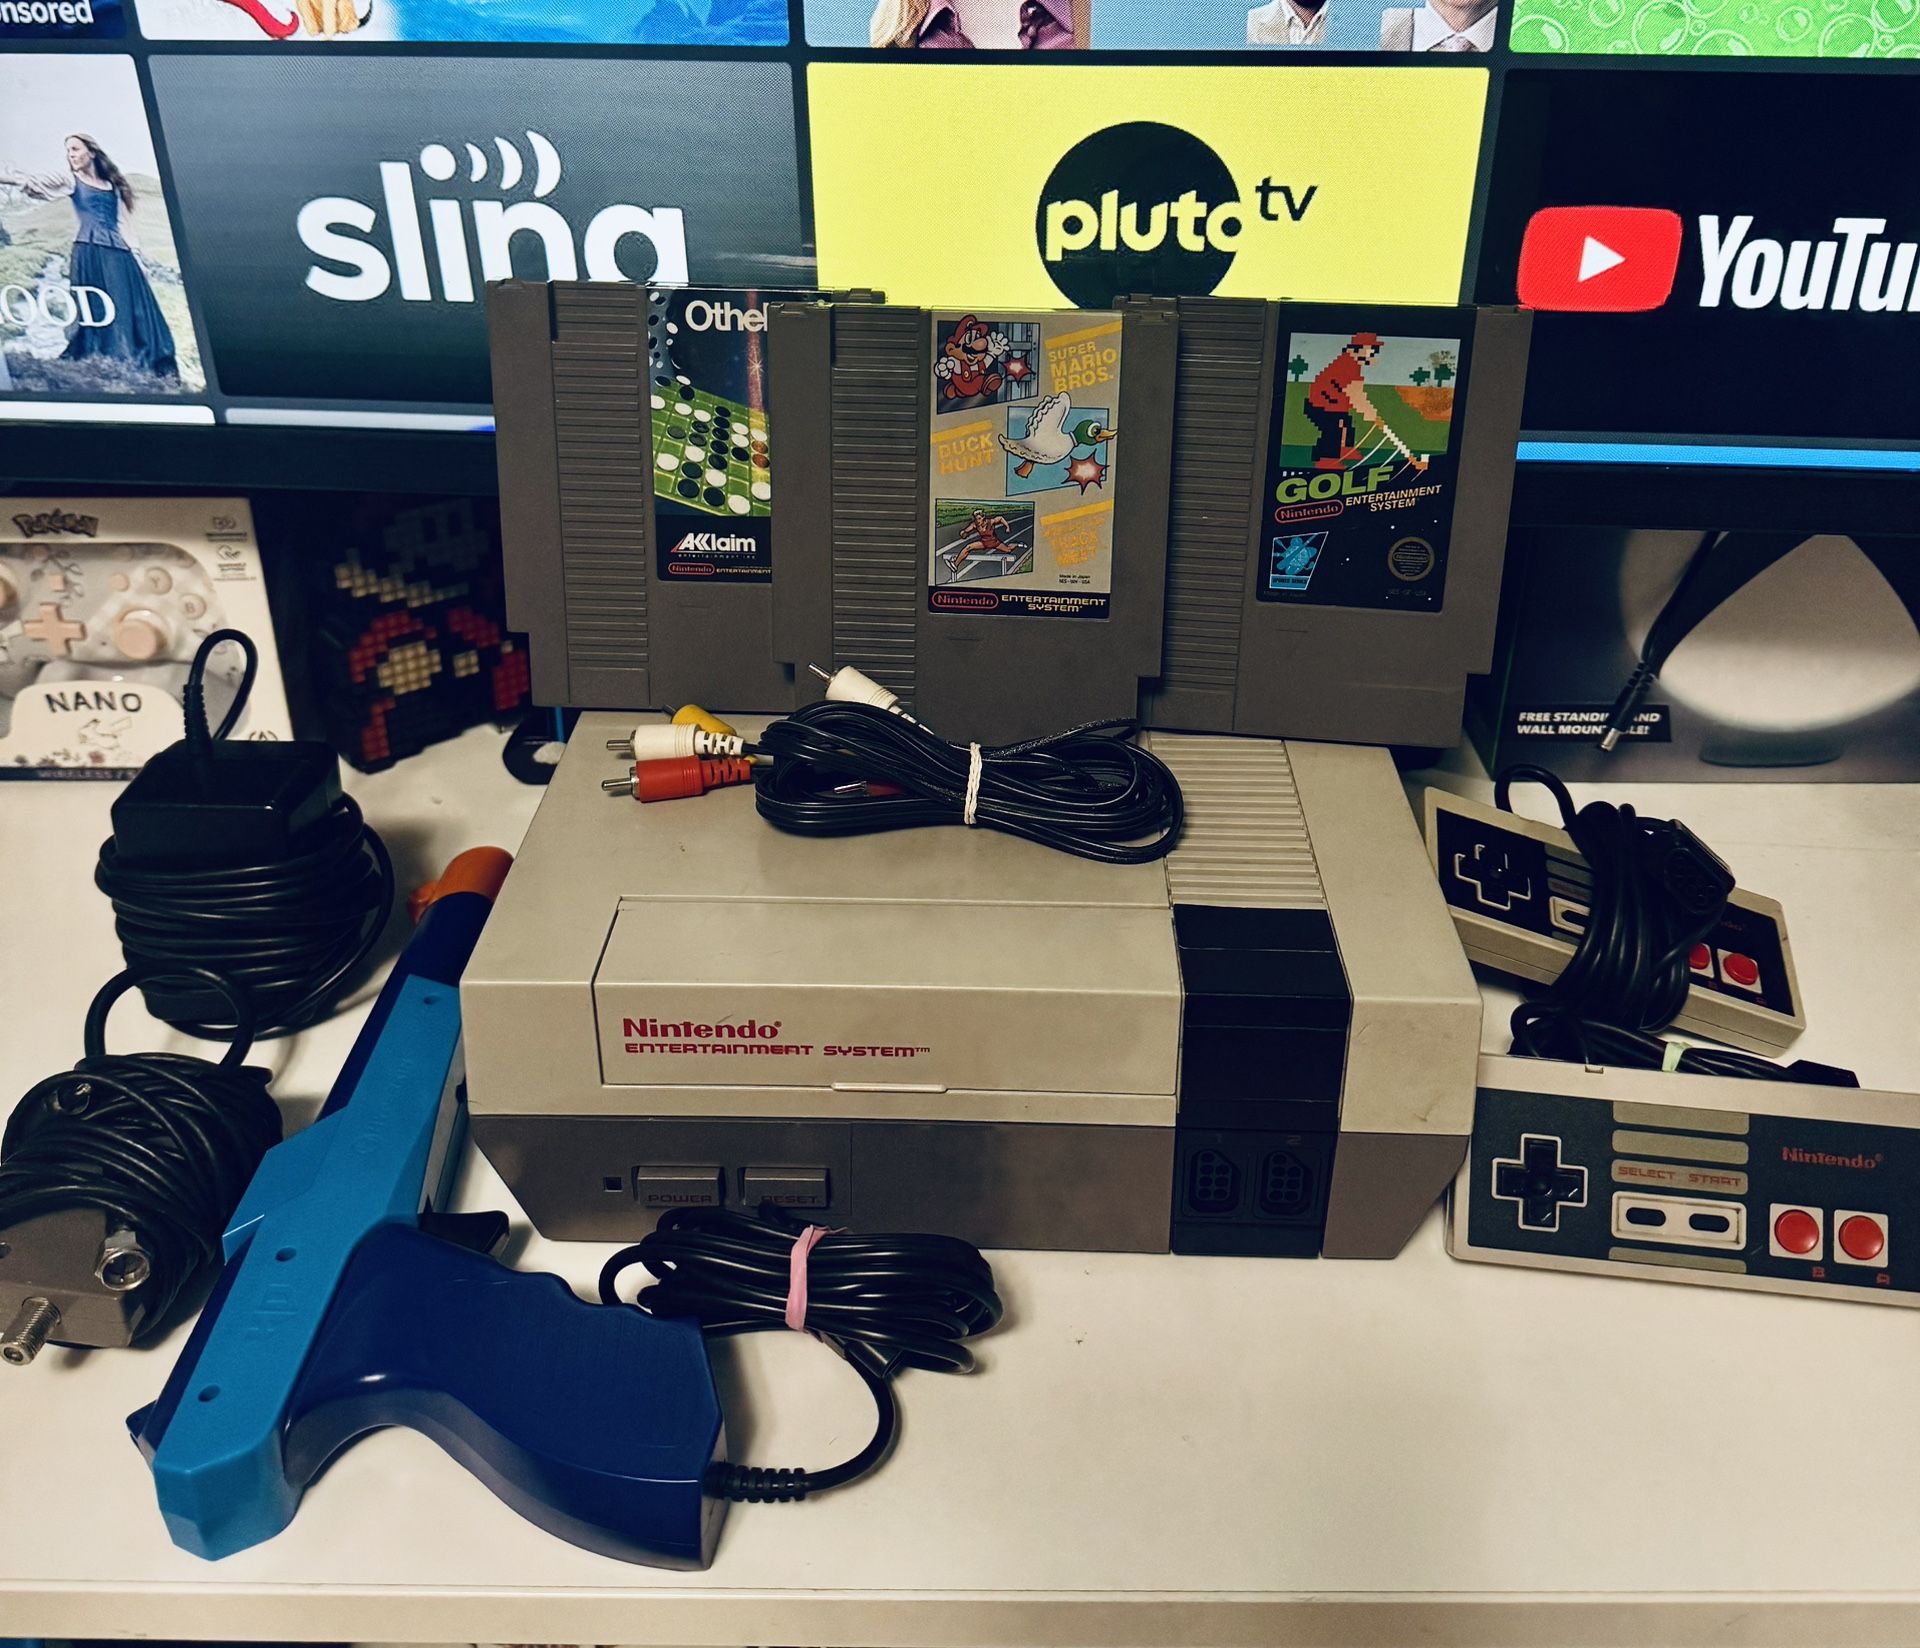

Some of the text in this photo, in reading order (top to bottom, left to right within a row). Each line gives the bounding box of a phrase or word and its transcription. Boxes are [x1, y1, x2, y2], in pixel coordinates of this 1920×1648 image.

[0, 0, 94, 24] nsored
[1045, 176, 1318, 262] pluto tv
[1698, 214, 1920, 312] YouTu
[0, 284, 116, 328] OOD
[1048, 341, 1096, 362] SUPER
[1050, 348, 1117, 378] MARIO
[1054, 366, 1114, 395] BROS.
[938, 433, 993, 460] DUCK
[940, 449, 994, 476] HUNT
[1276, 465, 1394, 504] GOLF
[1280, 484, 1443, 520] Nintendo ENTERTAINMENT
[1370, 497, 1416, 513] SYSTEM
[672, 564, 712, 573] Nintendo
[937, 594, 1106, 606] Nintendo ENTERTAINMENT
[1028, 603, 1080, 612] SYSTEM
[45, 691, 142, 713] NANO
[1518, 712, 1551, 722] FREE
[1633, 713, 1661, 722] ND
[1517, 725, 1556, 735] WALL
[624, 1043, 814, 1056] ENTERTAINMENT
[1618, 1165, 1741, 1188] SELECT START
[648, 1194, 712, 1203] POWER
